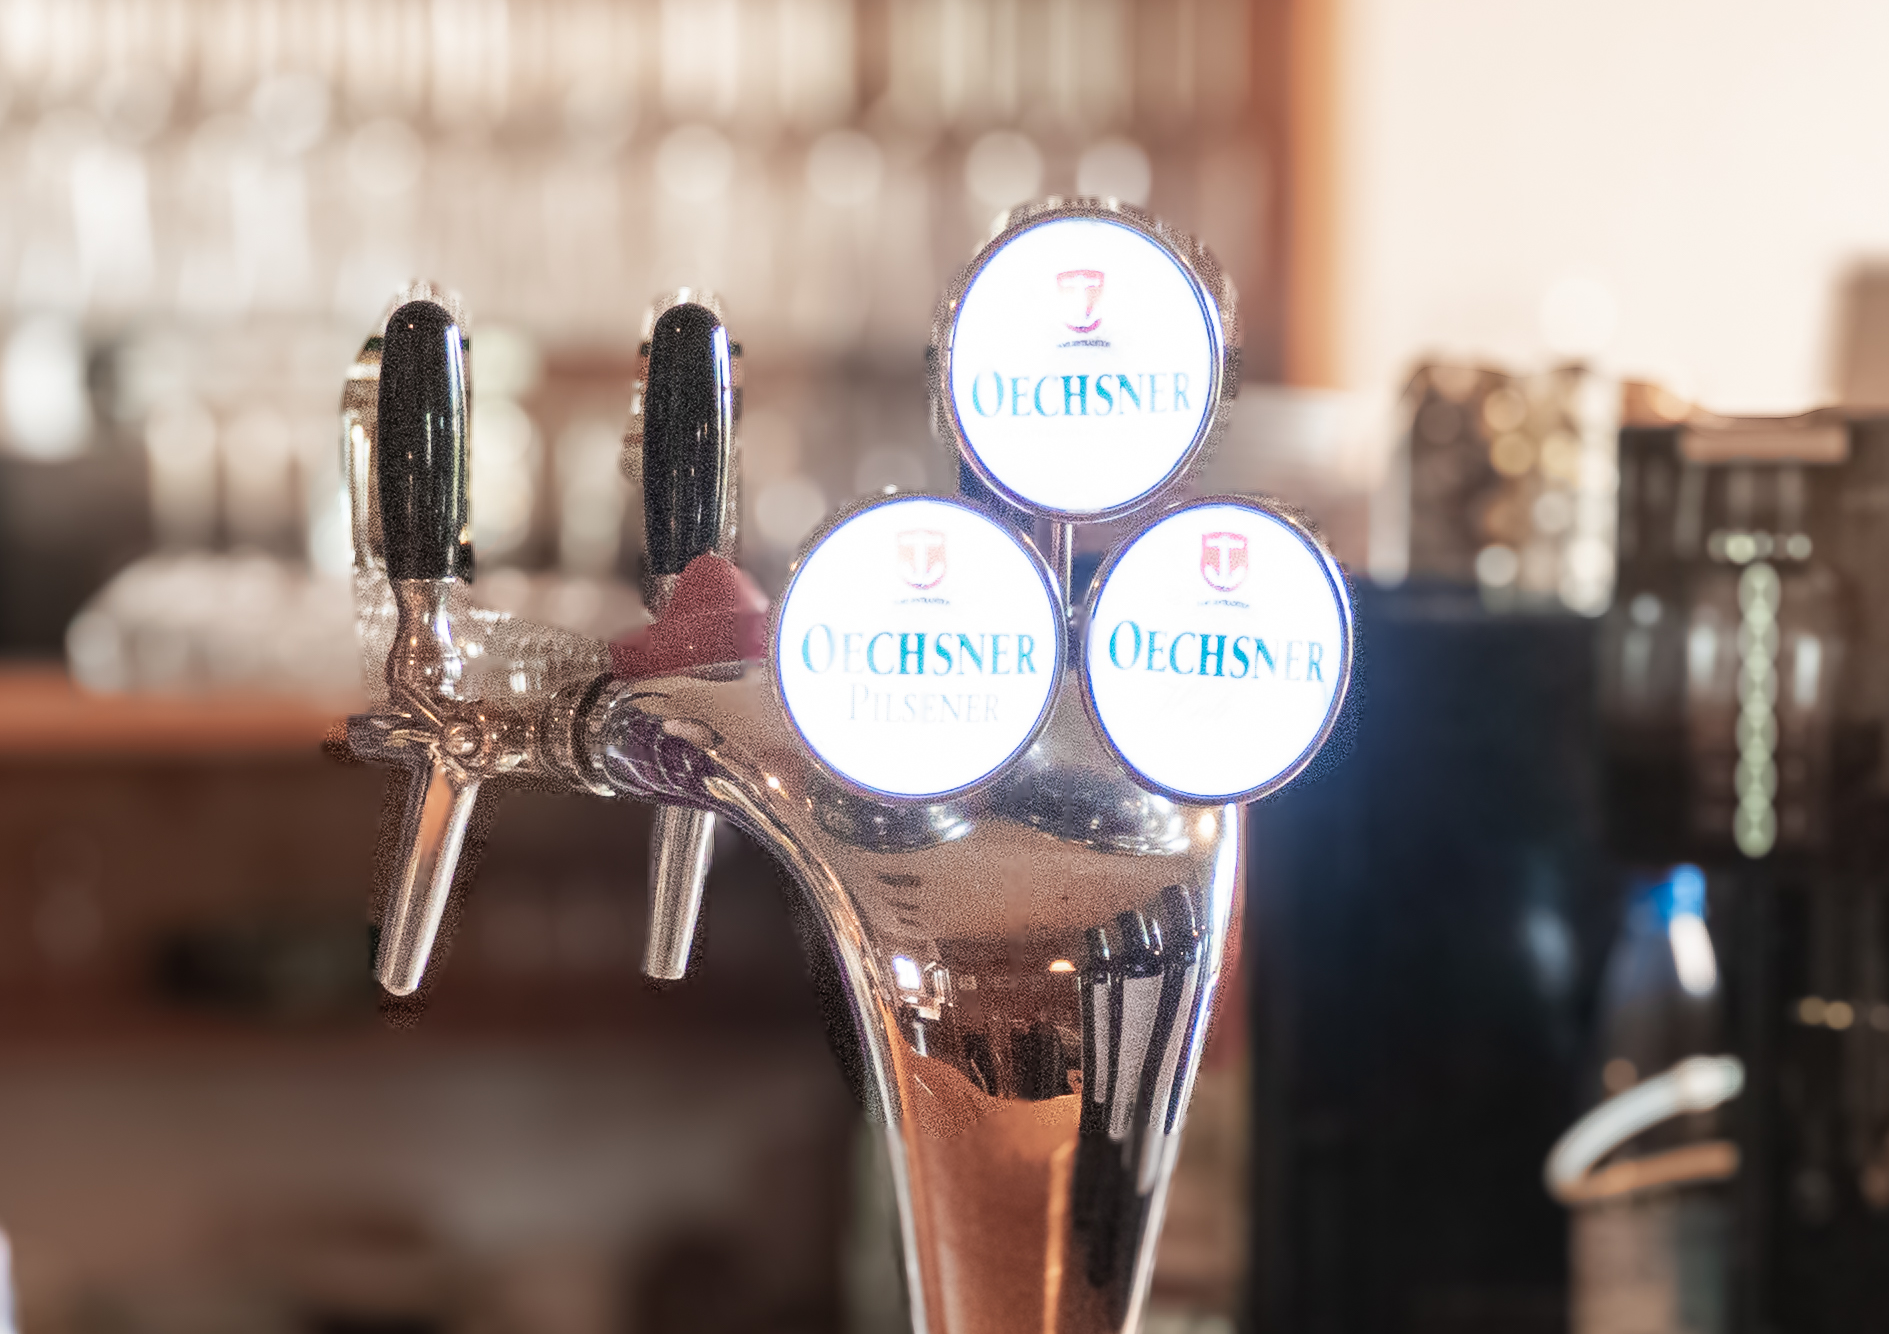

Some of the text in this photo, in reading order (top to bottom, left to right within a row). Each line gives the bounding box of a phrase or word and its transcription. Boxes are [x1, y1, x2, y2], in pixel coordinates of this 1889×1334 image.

[972, 370, 1191, 417] OECHSNER
[801, 623, 1037, 676] OECHSNER
[1109, 620, 1324, 682] OECHSNER
[849, 682, 999, 723] PILSENER
